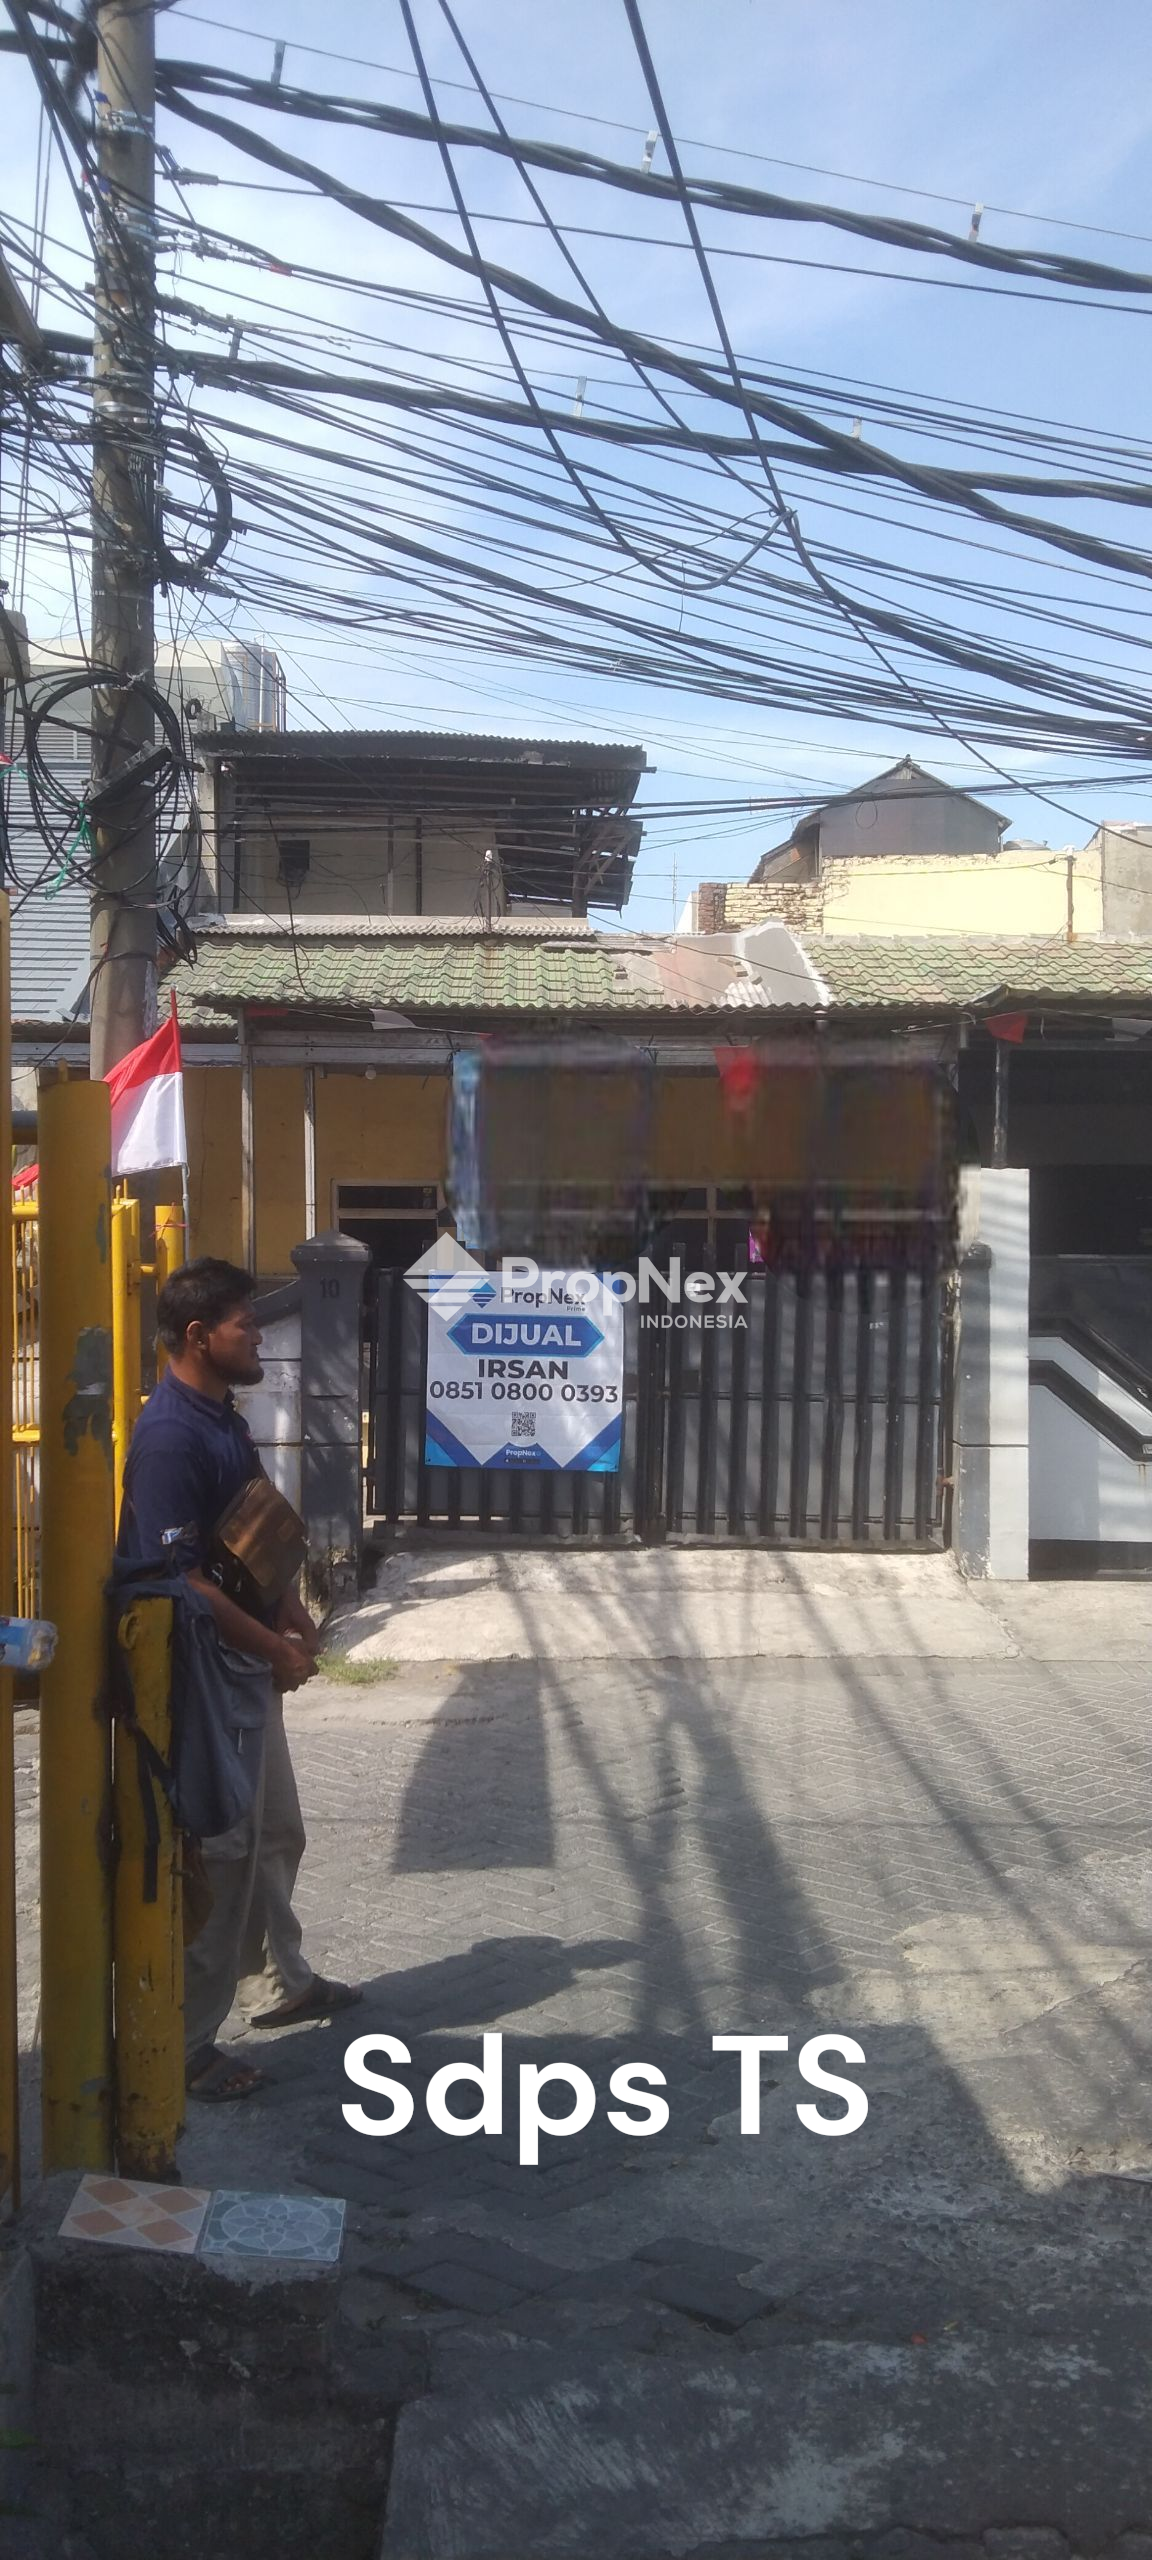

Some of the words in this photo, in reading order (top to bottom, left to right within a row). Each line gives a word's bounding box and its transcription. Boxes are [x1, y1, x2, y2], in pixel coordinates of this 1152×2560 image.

[320, 1278, 340, 1298] 10
[501, 1287, 585, 1308] PropNex
[471, 1323, 581, 1347] DIJUAL
[478, 1359, 568, 1379] IRSAN
[429, 1381, 483, 1400] 0851
[491, 1382, 553, 1401] 0800
[561, 1384, 618, 1403] 0393
